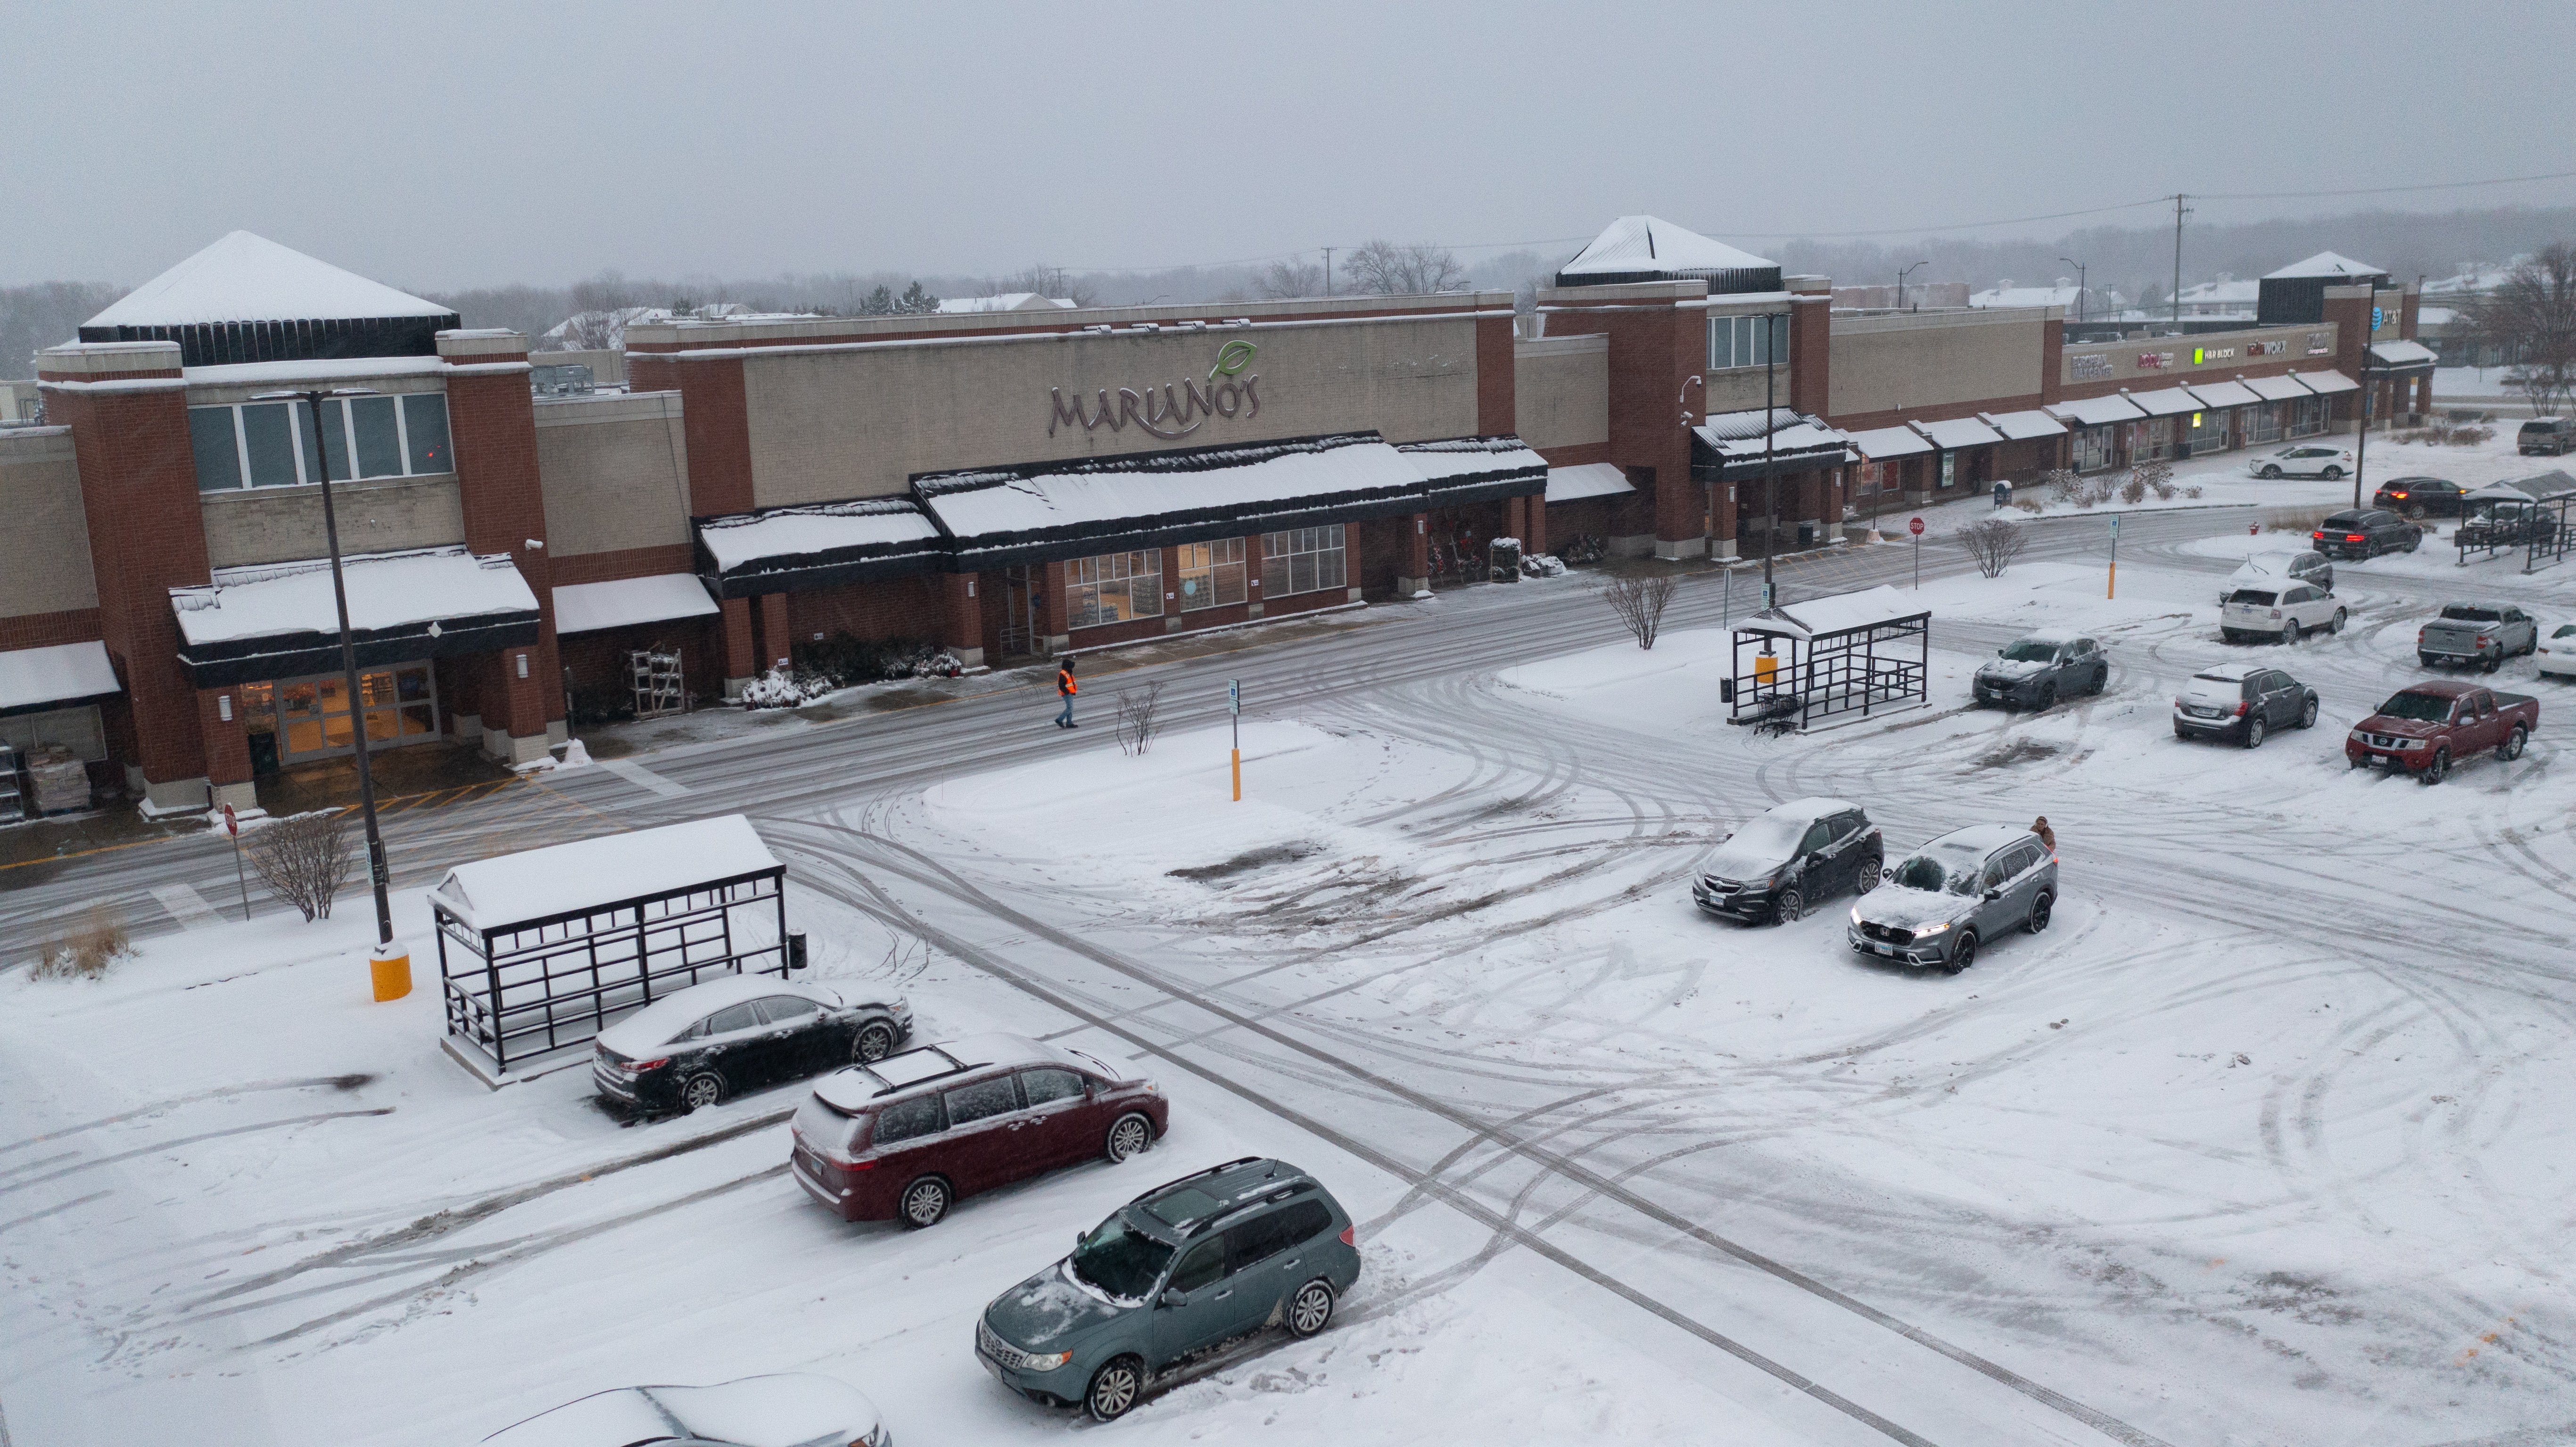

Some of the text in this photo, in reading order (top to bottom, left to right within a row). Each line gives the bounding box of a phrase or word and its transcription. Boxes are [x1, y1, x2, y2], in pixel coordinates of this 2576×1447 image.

[2383, 309, 2402, 325] AT&T
[2072, 354, 2107, 367] EUROPEAN
[2204, 348, 2235, 360] H&R BLOCK
[2072, 364, 2113, 378] WAX CENTER
[1049, 374, 1260, 439] MARIANO'S
[225, 813, 236, 827] STOP
